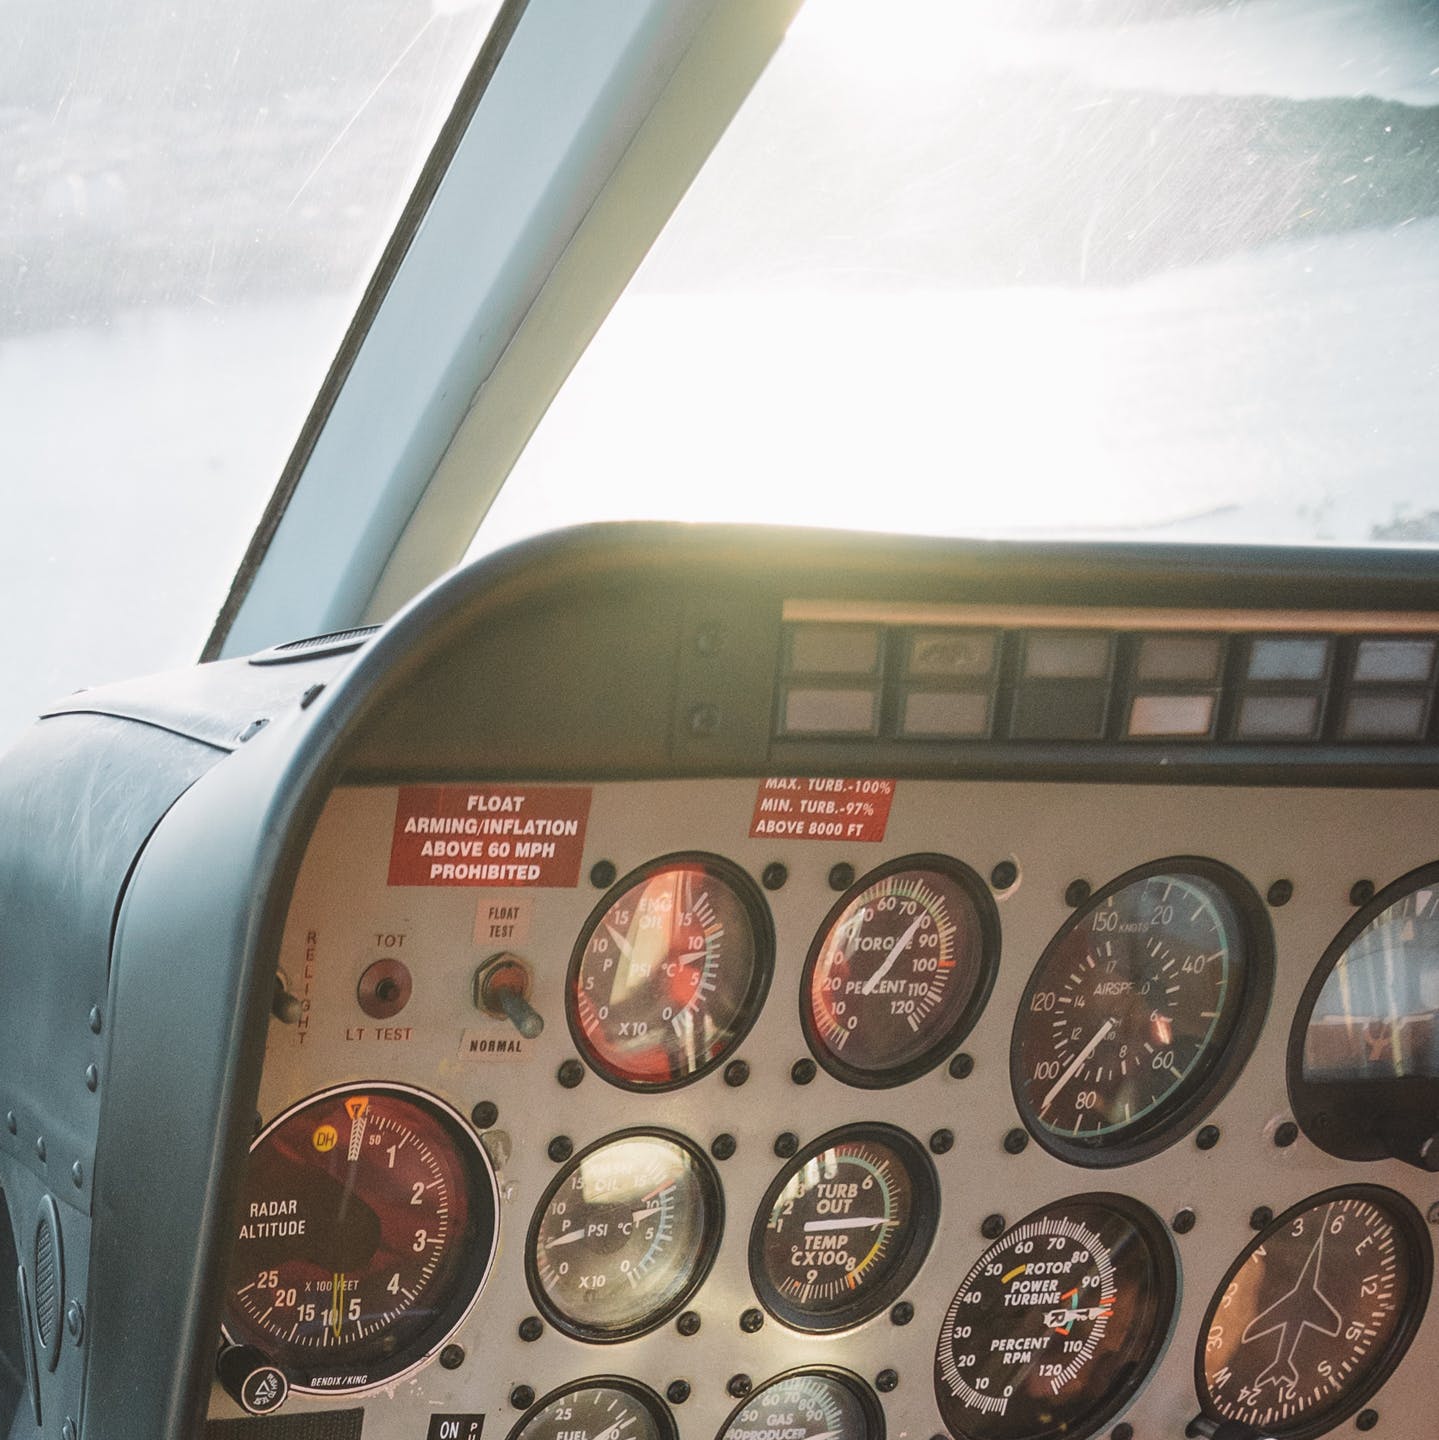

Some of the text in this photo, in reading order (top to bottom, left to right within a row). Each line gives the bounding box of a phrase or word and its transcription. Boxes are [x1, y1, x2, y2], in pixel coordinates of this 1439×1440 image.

[765, 777, 891, 794] MAX. TURB.-100%
[467, 795, 525, 812] FLOAT
[760, 798, 874, 817] MIN. TURB.-97%
[404, 817, 578, 836] ARMING/INFLATION
[755, 820, 864, 837] ABOVE 8000 FT
[420, 840, 556, 858] ABOVE 60 MPH
[430, 863, 541, 880] PROHIBITED
[488, 907, 520, 920] FLOAT
[489, 925, 515, 938] TEST
[375, 934, 407, 948] TOT
[345, 1028, 413, 1041] LT TEST
[469, 1039, 522, 1052] NORMAL
[386, 1145, 397, 1168] 1
[410, 1182, 425, 1205] 2
[816, 1184, 858, 1199] TURB
[250, 1200, 297, 1218] RADAR
[816, 1199, 853, 1214] OUT
[239, 1220, 306, 1240] ALTITUDE
[413, 1229, 427, 1252] 3
[804, 1235, 849, 1250] TEMP
[1024, 1261, 1072, 1275] ROTOR
[387, 1273, 400, 1295] 4
[1011, 1279, 1059, 1293] POWER
[1003, 1291, 1061, 1306] TURBINE
[348, 1298, 361, 1321] 5
[990, 1337, 1050, 1351] PERCENT
[1003, 1351, 1032, 1365] RPM
[310, 1375, 368, 1387] BENDIX/KING
[766, 1413, 794, 1425] GAS
[440, 1421, 458, 1439] ON
